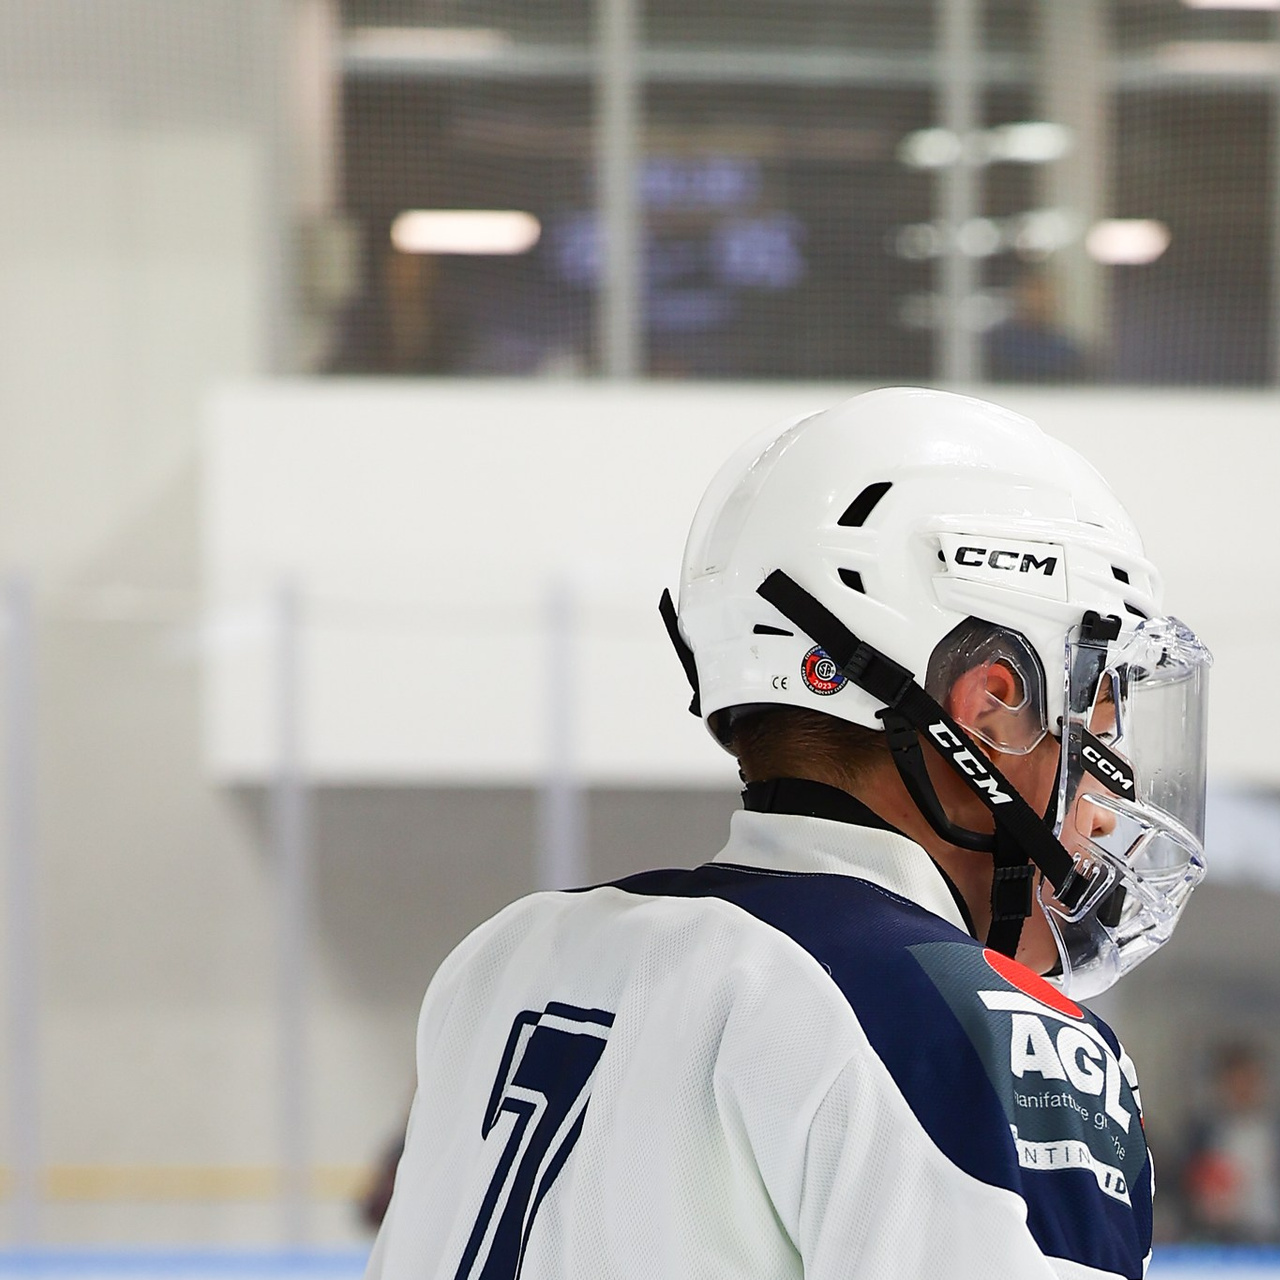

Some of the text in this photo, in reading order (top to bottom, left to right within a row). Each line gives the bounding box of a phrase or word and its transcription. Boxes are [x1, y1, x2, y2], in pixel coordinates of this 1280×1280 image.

[954, 546, 1057, 576] CCM
[772, 676, 788, 690] CE
[813, 679, 832, 690] 2023
[928, 718, 1013, 805] CCM
[1082, 744, 1134, 790] CCM
[1010, 1013, 1132, 1135] AGL
